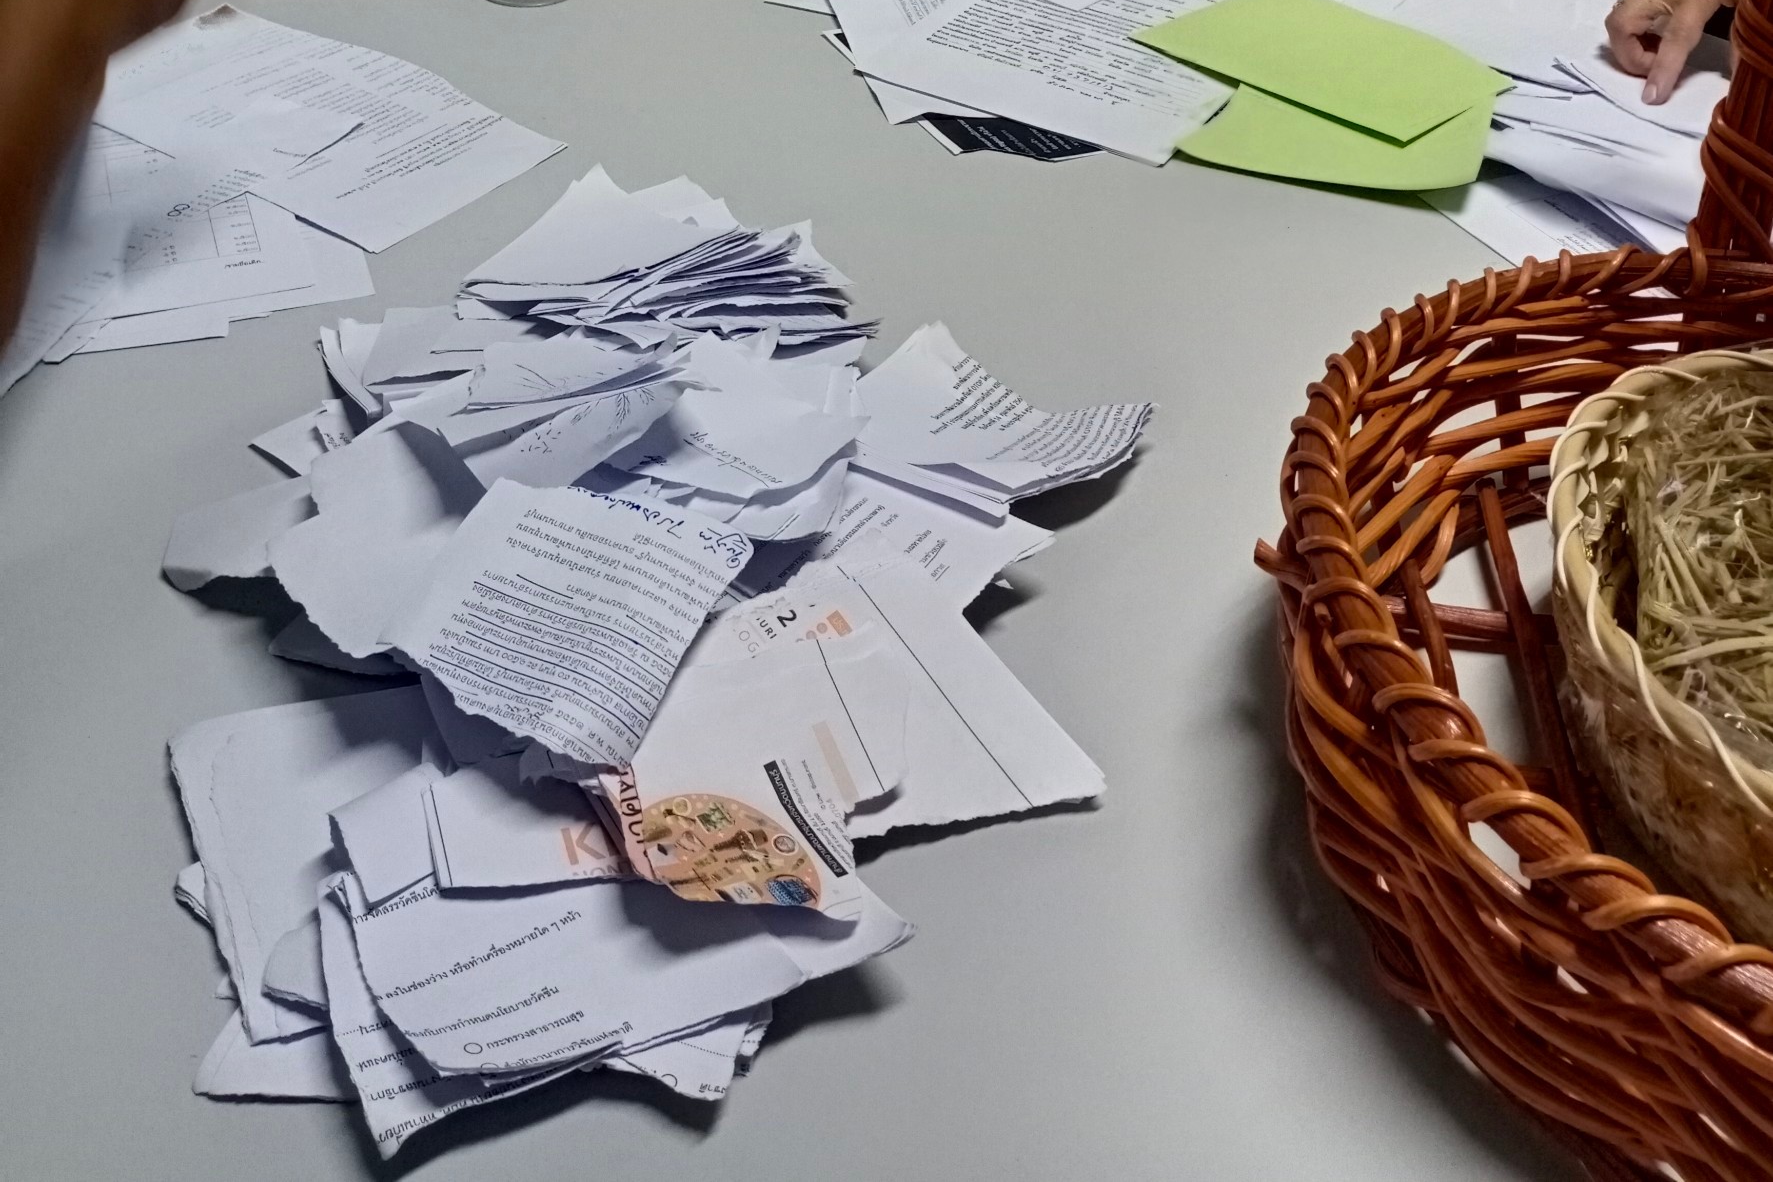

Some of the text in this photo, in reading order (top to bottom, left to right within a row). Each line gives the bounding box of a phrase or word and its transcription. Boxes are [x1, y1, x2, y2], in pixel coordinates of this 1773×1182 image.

[755, 615, 777, 639] URI
[775, 605, 799, 628] 2
[736, 627, 760, 654] OG
[557, 908, 582, 926] หน้า
